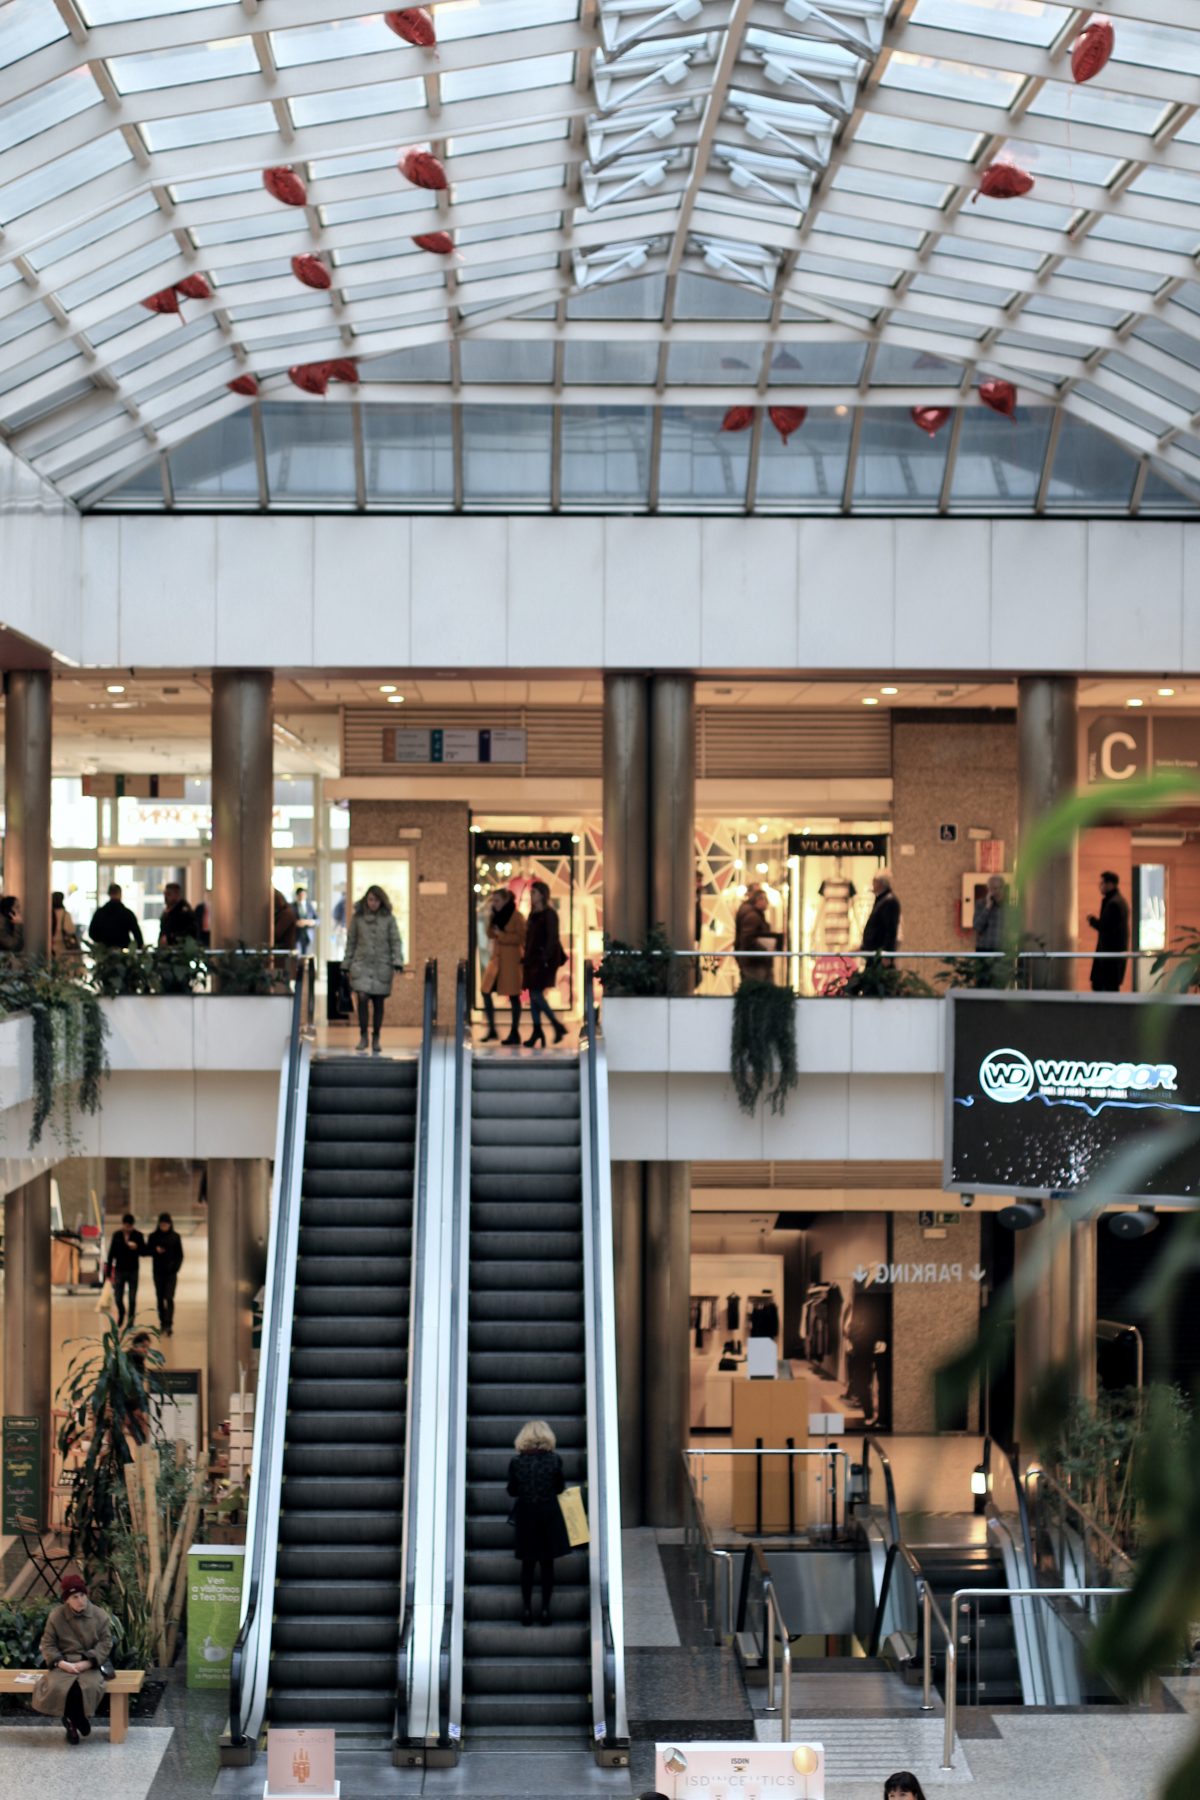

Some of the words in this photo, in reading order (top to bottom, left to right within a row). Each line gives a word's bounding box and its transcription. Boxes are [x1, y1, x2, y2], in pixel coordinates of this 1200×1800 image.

[1101, 731, 1137, 780] C
[487, 839, 561, 850] VILAGALLO
[801, 840, 874, 852] VILAGALLO
[1034, 1060, 1177, 1090] WINDOOR
[206, 1576, 225, 1585] Ven
